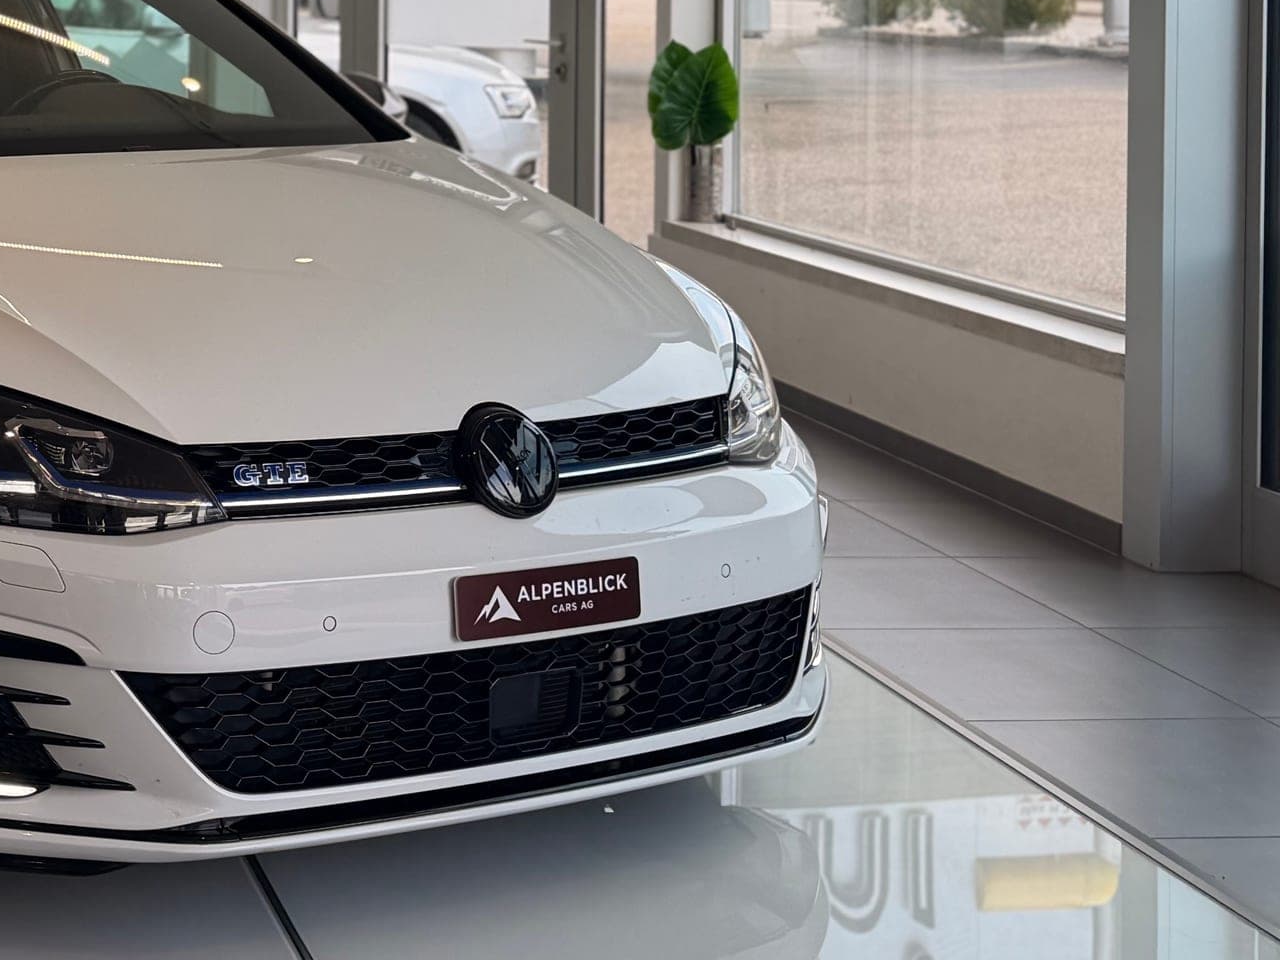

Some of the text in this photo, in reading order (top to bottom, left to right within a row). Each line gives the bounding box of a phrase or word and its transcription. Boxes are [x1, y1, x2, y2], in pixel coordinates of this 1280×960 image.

[233, 461, 309, 487] GTE
[517, 572, 628, 603] ALPENBLICK
[551, 599, 595, 614] CARS AG
